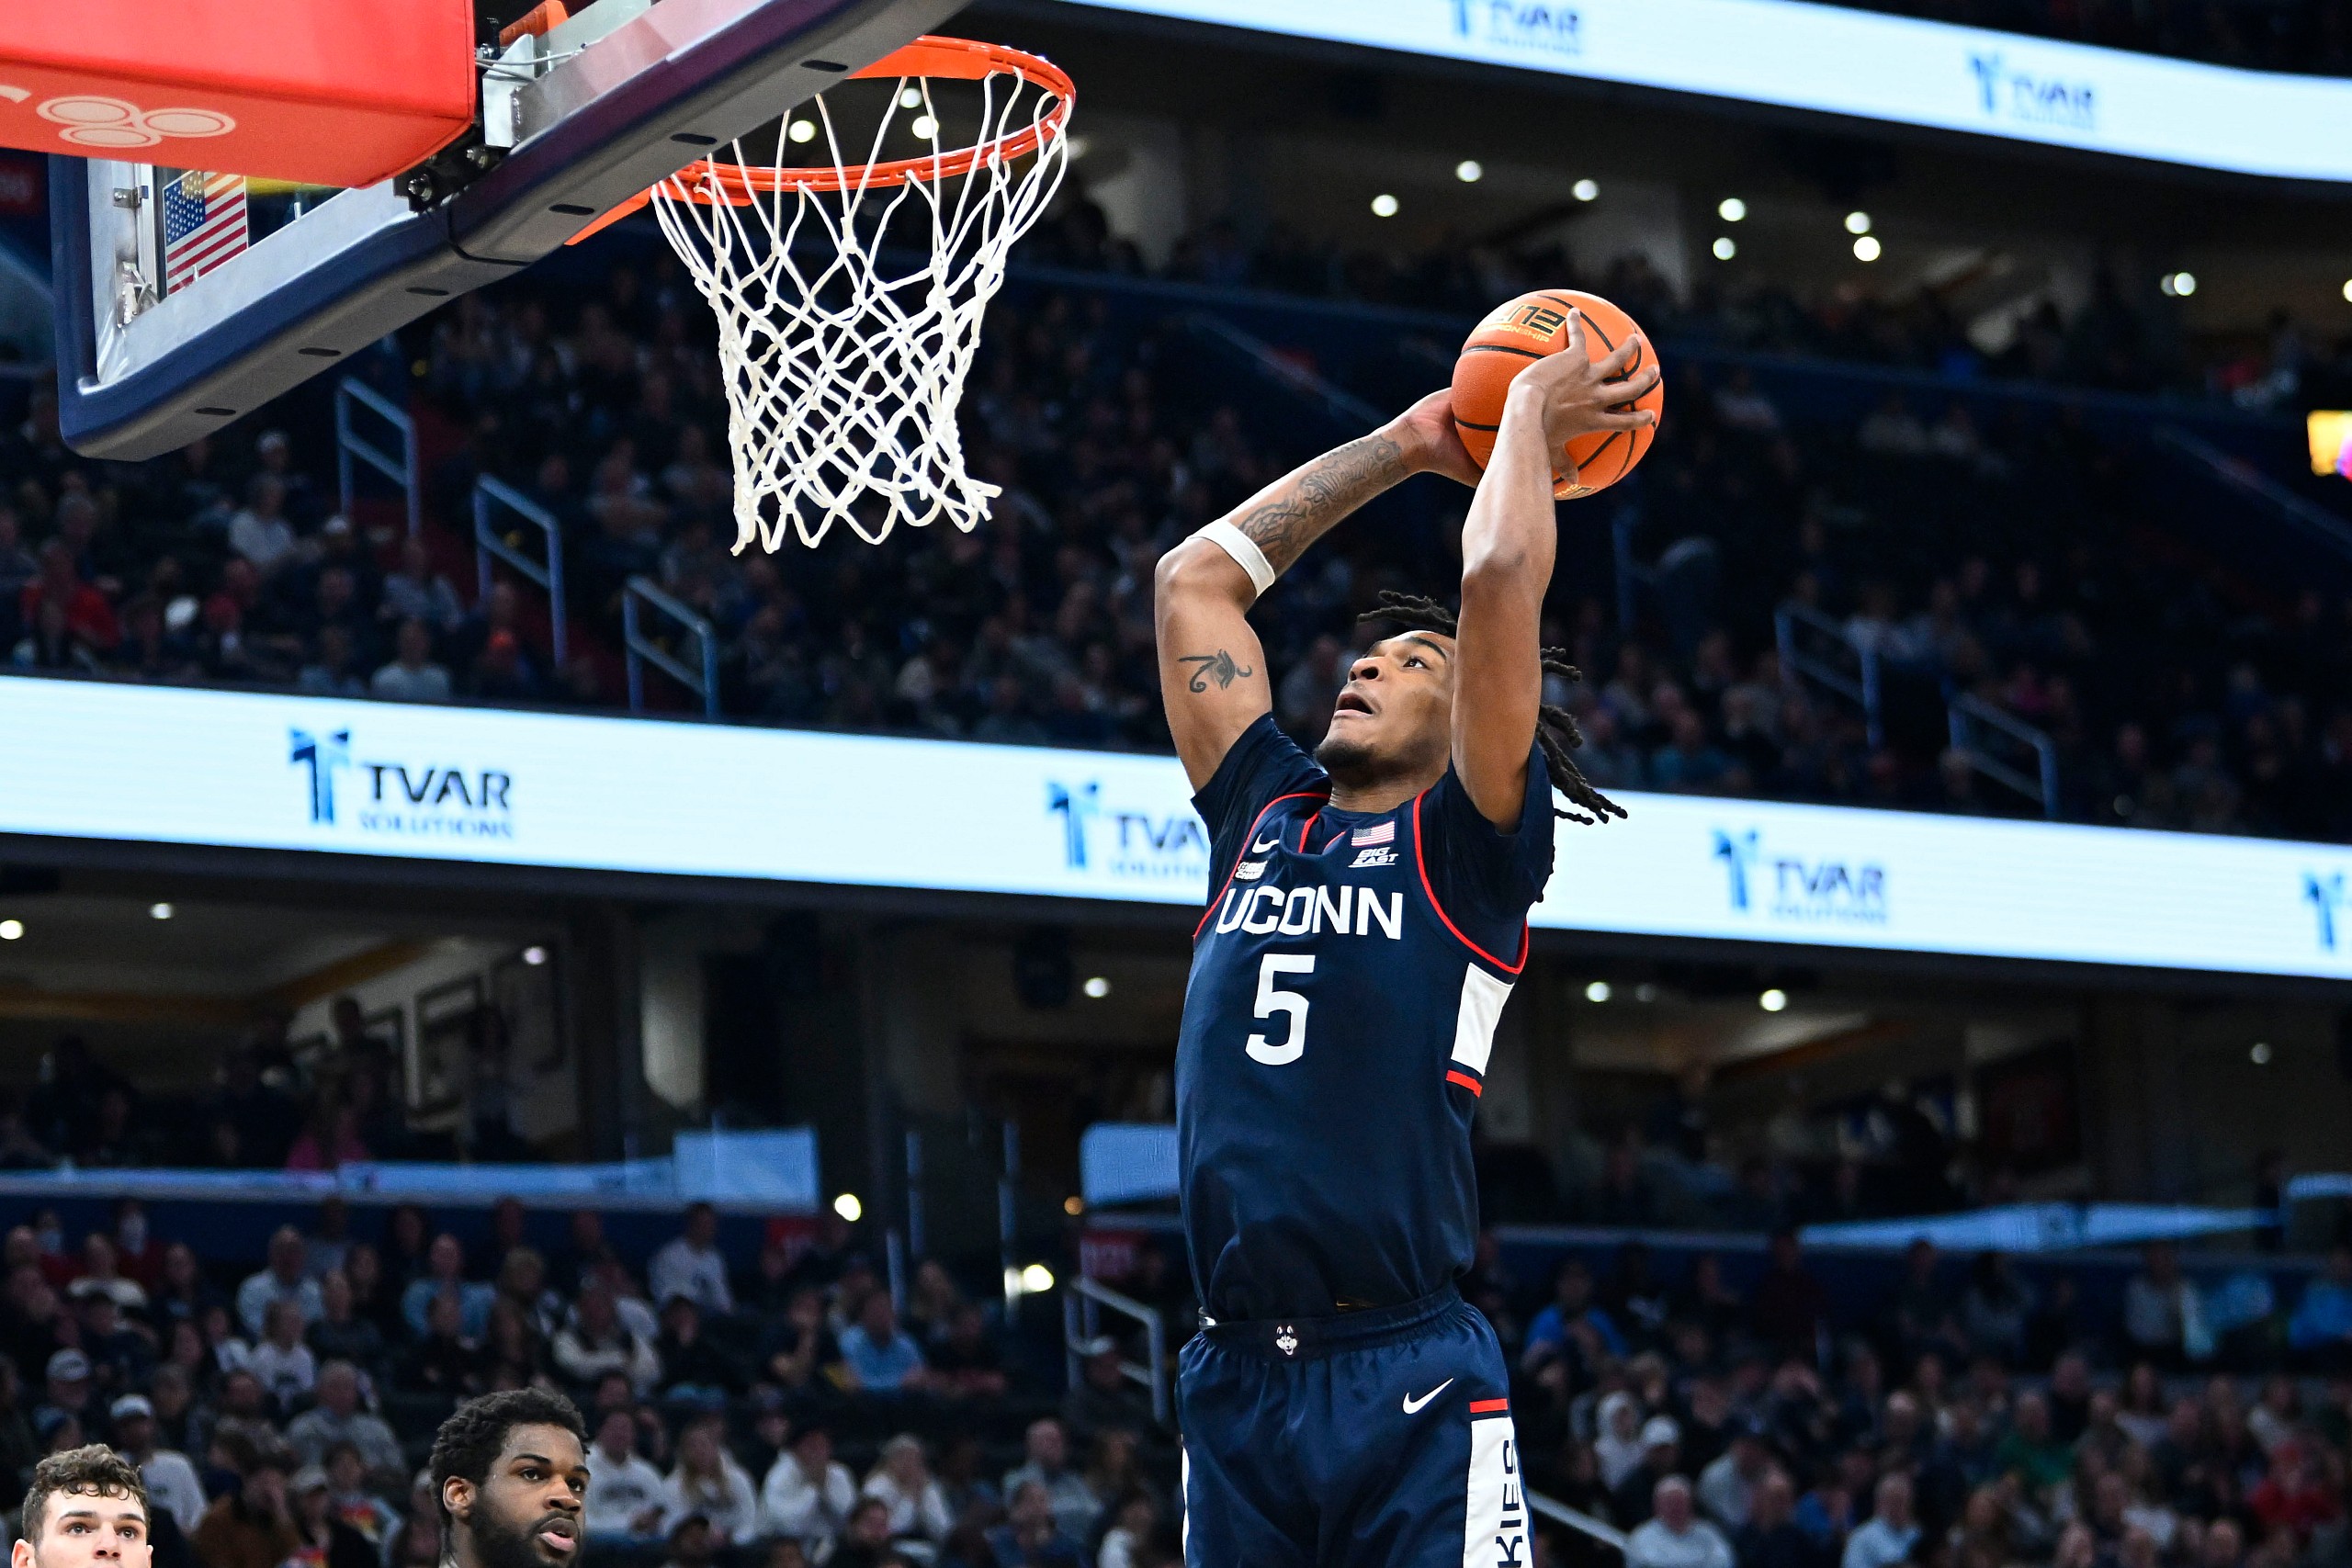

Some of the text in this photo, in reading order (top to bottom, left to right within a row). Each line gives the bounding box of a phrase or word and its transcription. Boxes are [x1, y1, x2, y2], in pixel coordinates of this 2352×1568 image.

[365, 765, 510, 808] TVAR
[360, 811, 513, 837] SOLUTIONS
[1112, 814, 1207, 852] TVA
[1352, 853, 1398, 864] EAST
[1356, 847, 1391, 858] BIG
[1773, 861, 1883, 902] TVAR
[1215, 885, 1404, 941] UCONN
[1245, 953, 1316, 1066] 5
